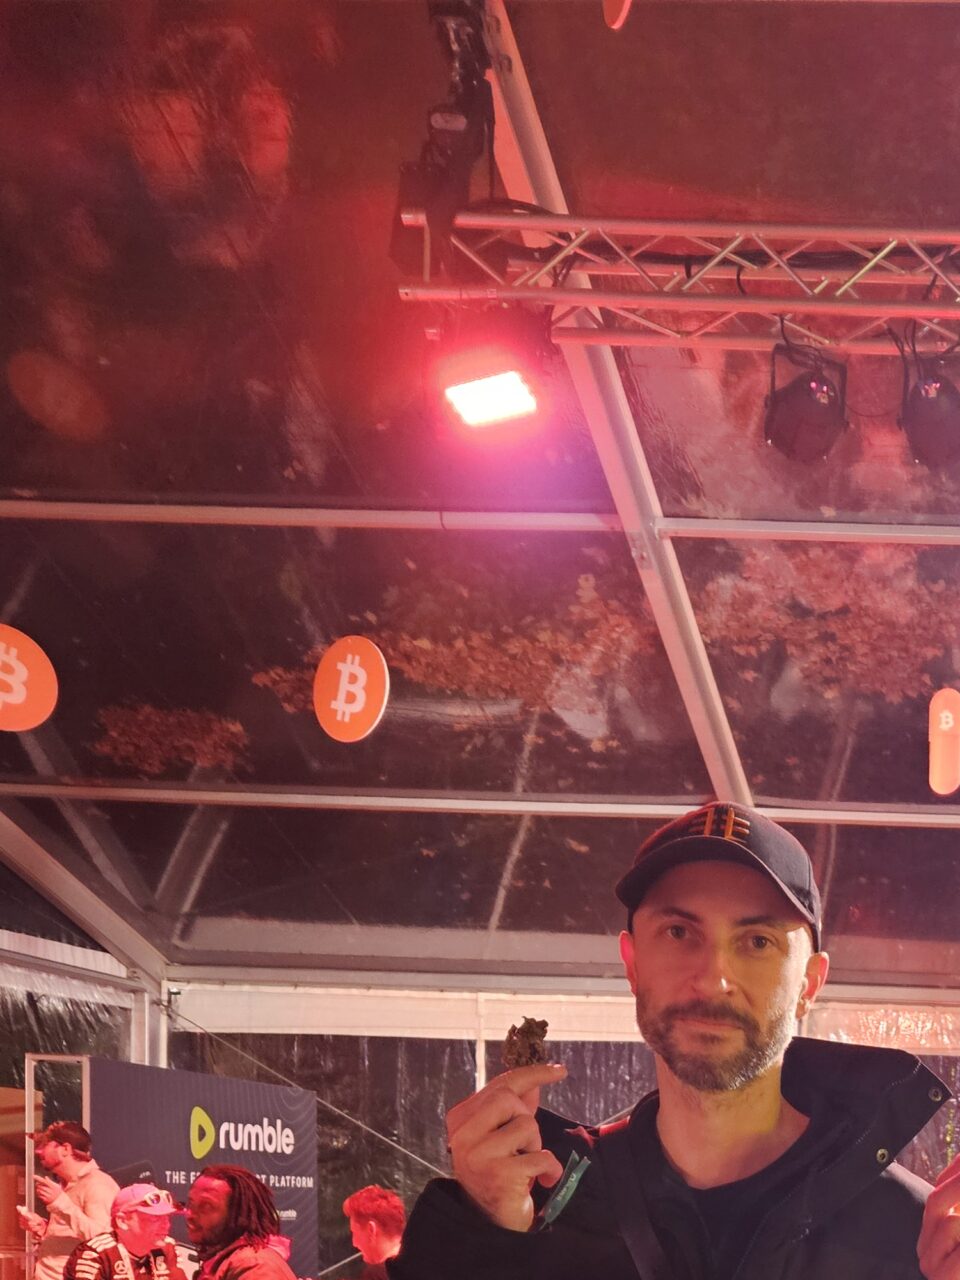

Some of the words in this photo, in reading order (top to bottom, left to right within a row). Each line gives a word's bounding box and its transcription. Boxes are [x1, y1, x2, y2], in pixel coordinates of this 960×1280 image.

[219, 1117, 295, 1155] rumble
[165, 1171, 187, 1185] THE
[269, 1175, 314, 1189] PLATFORM
